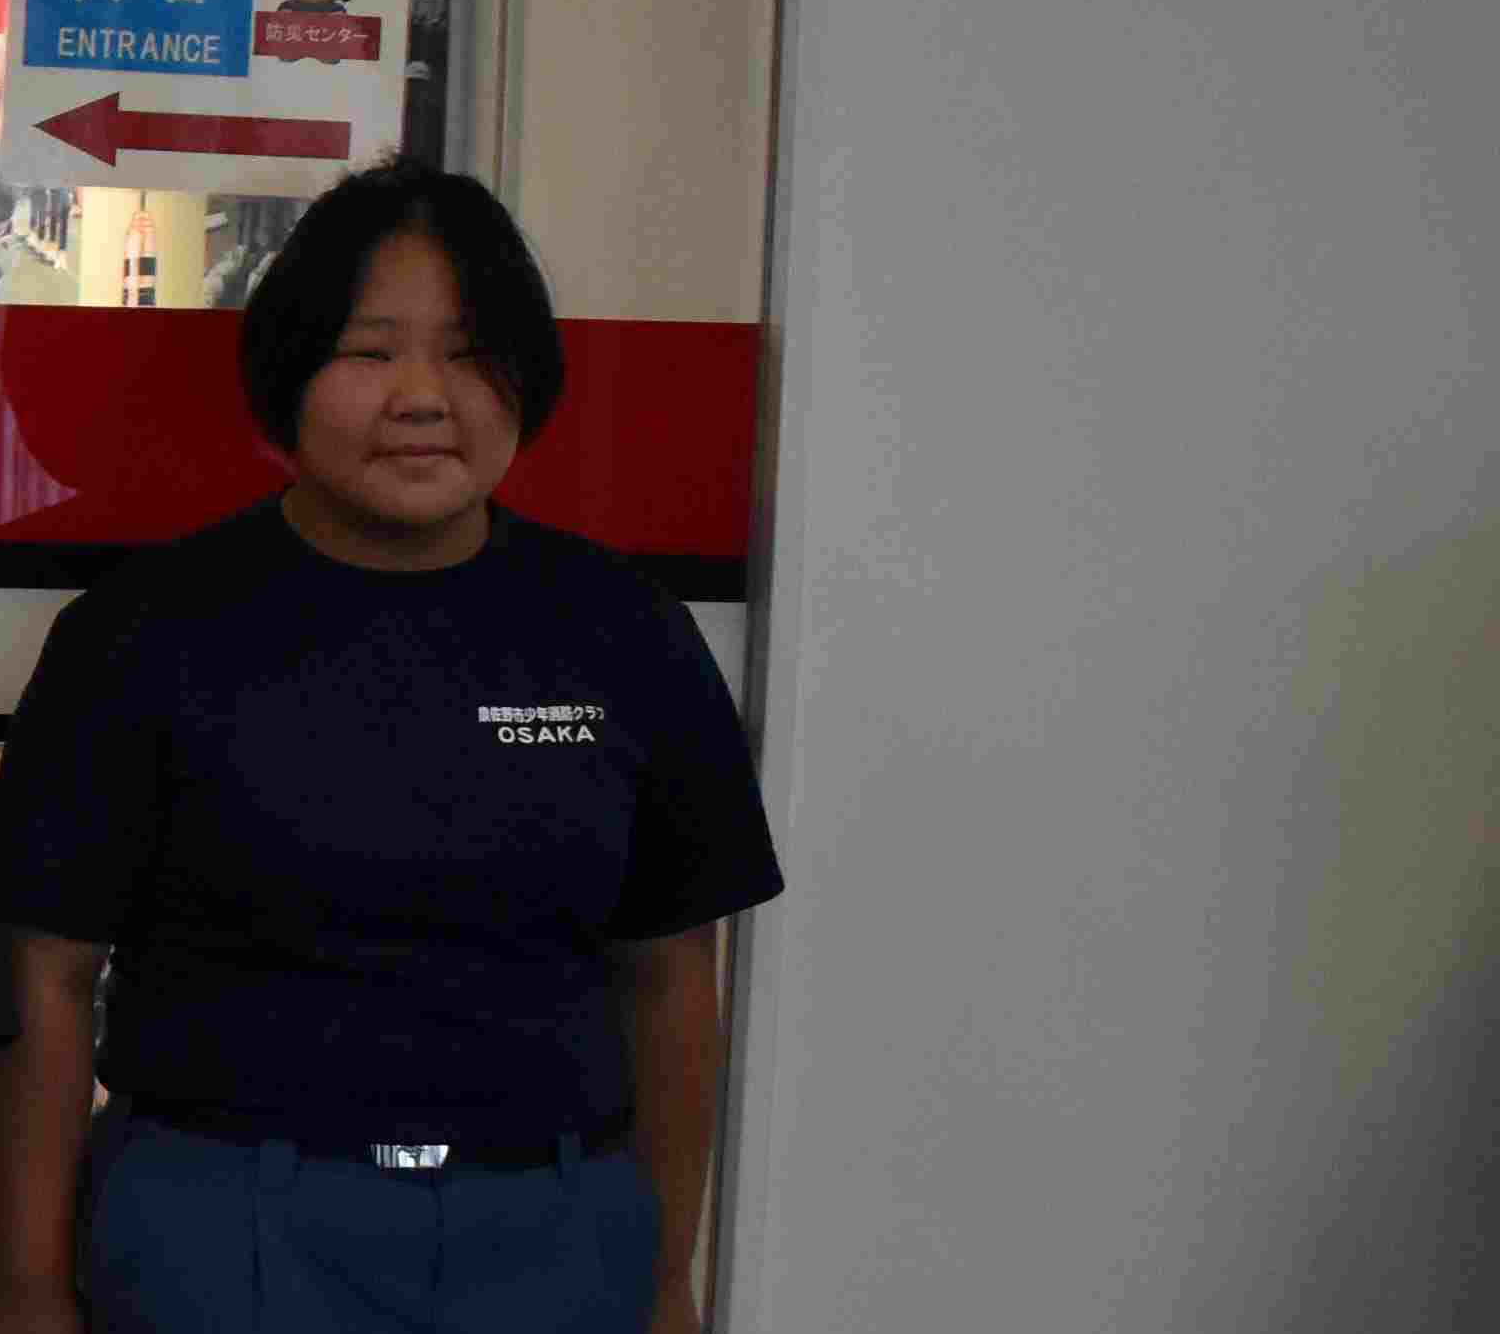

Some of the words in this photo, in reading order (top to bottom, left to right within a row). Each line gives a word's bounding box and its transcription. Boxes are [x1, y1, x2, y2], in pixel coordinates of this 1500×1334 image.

[266, 24, 369, 43] 防災センター
[59, 27, 221, 64] ENTRANCE
[497, 724, 596, 744] OSAKA
